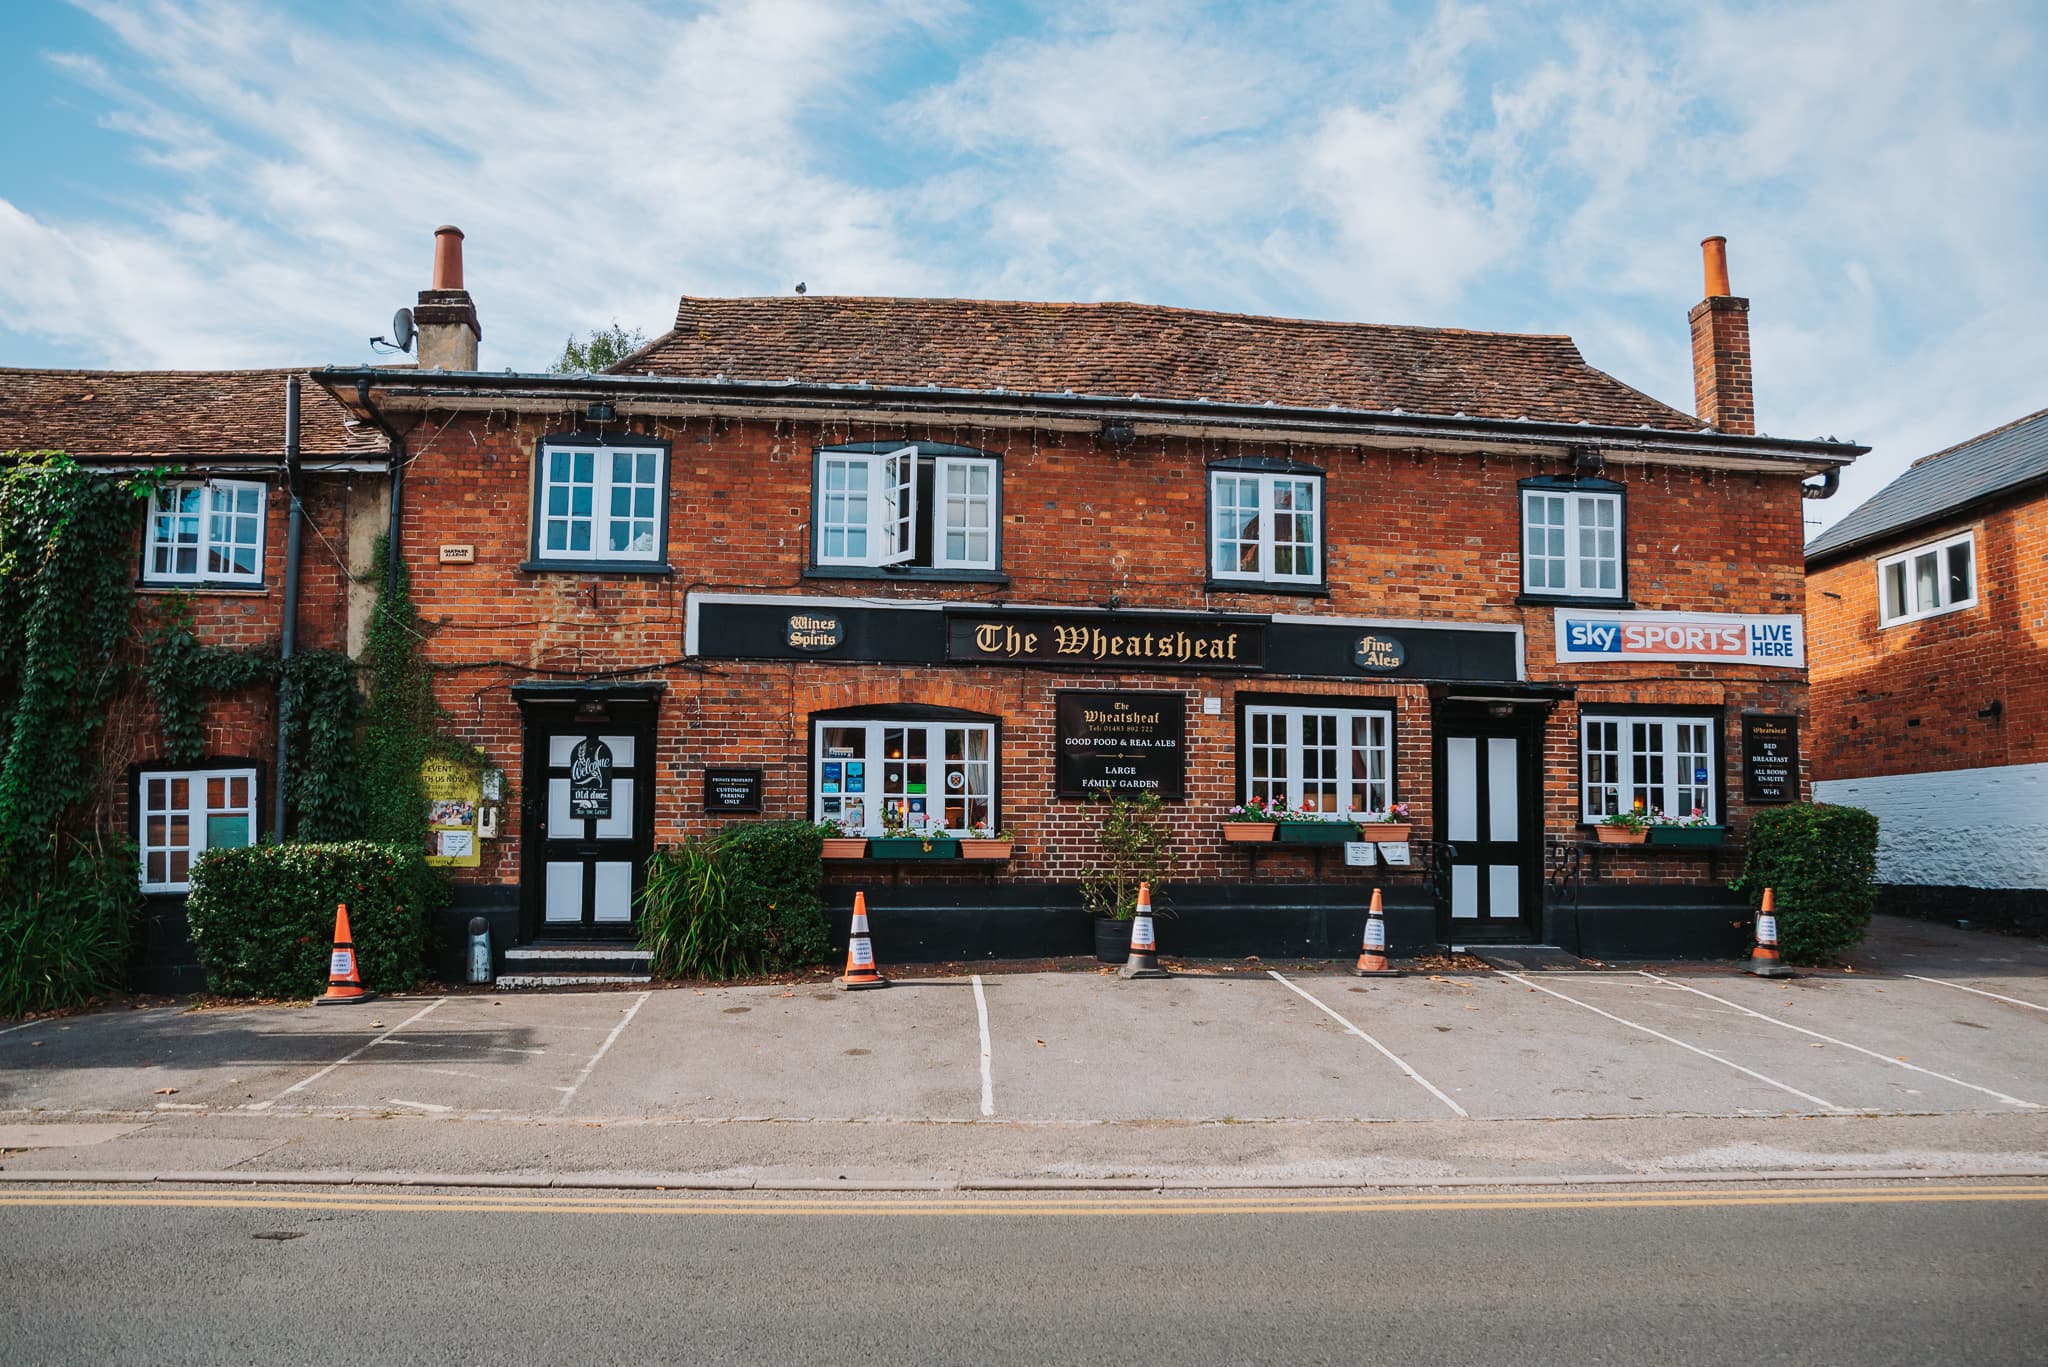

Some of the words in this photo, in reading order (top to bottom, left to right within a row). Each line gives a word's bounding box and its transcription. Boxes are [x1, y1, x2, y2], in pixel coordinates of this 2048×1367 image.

[790, 615, 837, 630] Wines
[790, 631, 837, 648] Spirits
[1571, 622, 1616, 651] sky
[1625, 626, 1742, 651] SPORTS
[1751, 624, 1792, 641] LIVE
[975, 623, 1038, 658] The
[1053, 624, 1238, 663] Wheatsheaf
[1357, 635, 1393, 655] Fine
[1752, 641, 1794, 657] HERE
[1364, 651, 1400, 667] Ales
[1114, 702, 1129, 710] The
[1083, 710, 1160, 725] Wheatsheaf
[1065, 737, 1091, 746] GOOD
[1093, 738, 1118, 746] FOOD
[1129, 739, 1152, 747] REAL
[1154, 739, 1176, 747] ALES
[572, 757, 611, 780] Welcome
[1105, 766, 1136, 775] LARGE
[1082, 779, 1117, 788] FAMILY
[1119, 780, 1159, 788] GARDEN
[575, 790, 590, 800] Old
